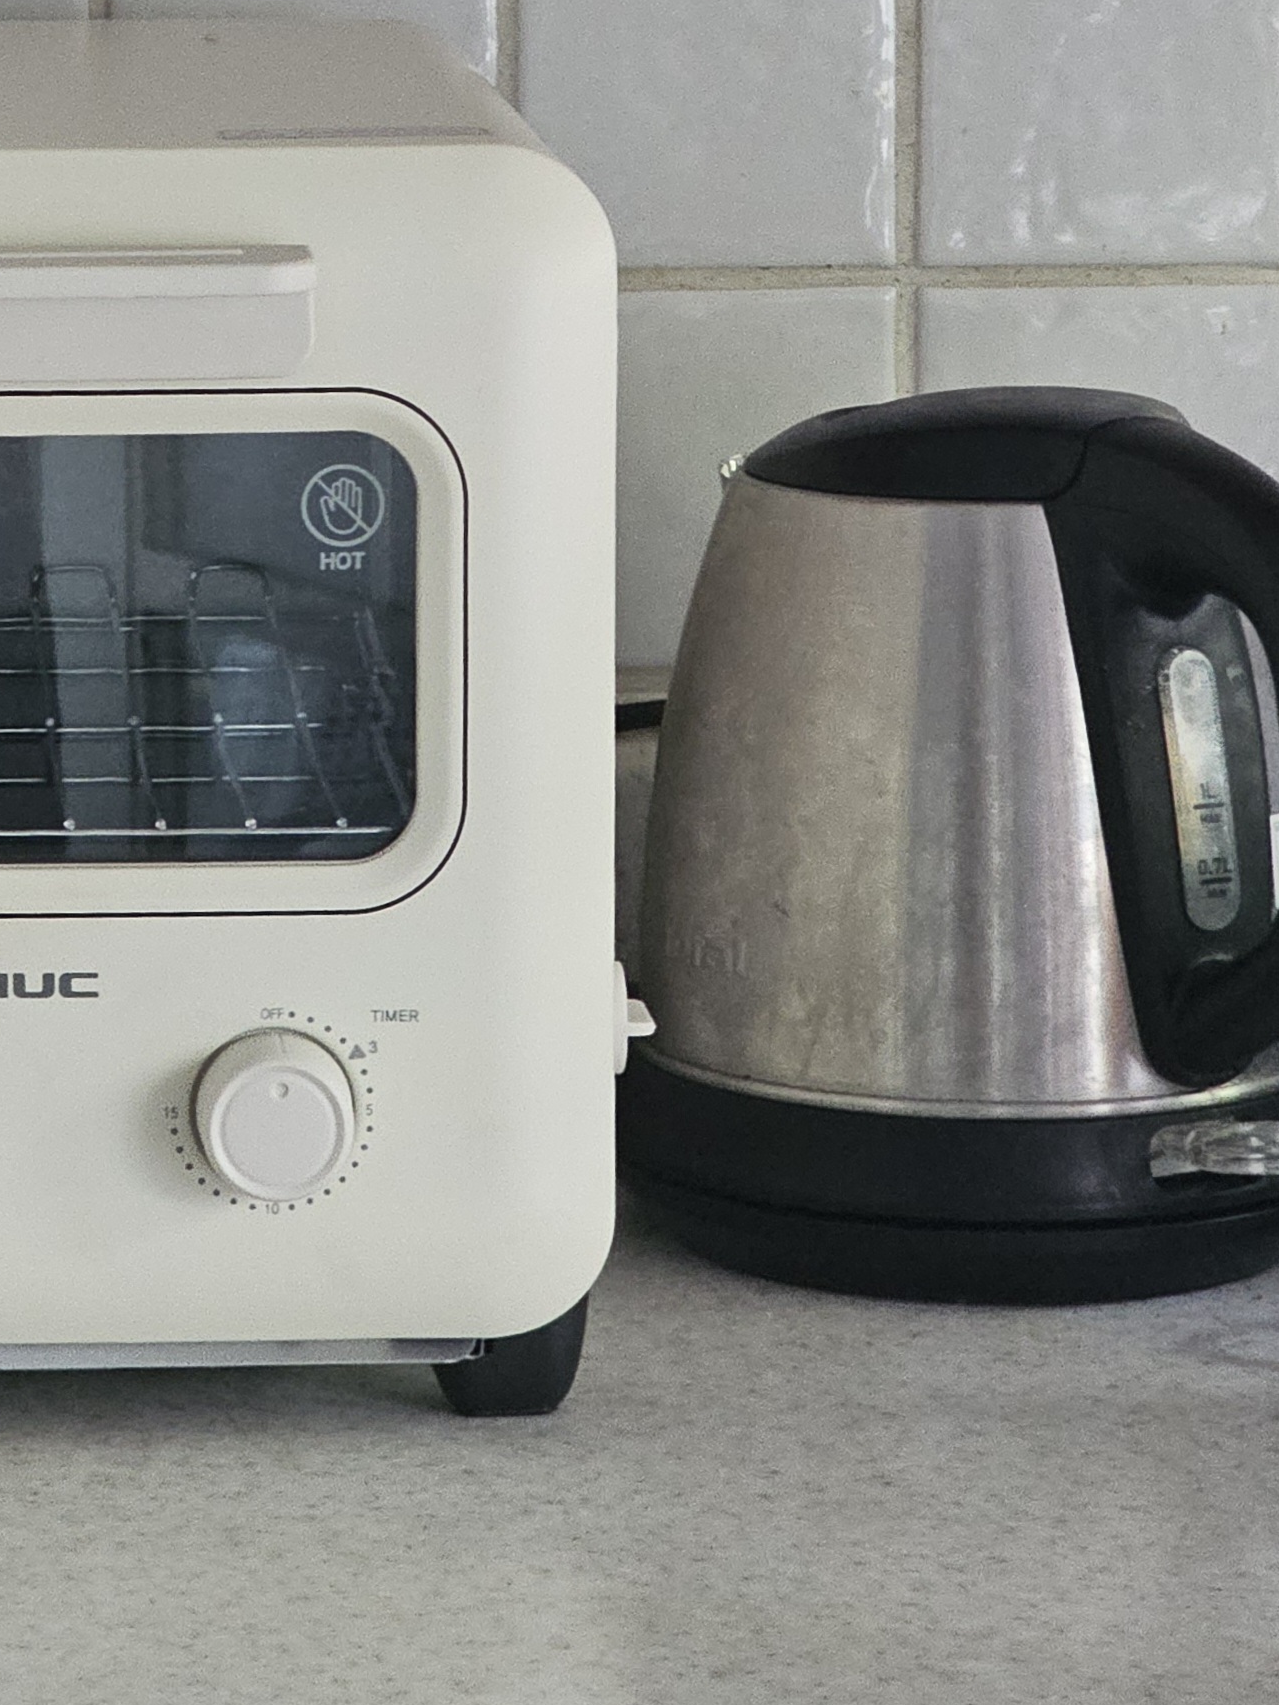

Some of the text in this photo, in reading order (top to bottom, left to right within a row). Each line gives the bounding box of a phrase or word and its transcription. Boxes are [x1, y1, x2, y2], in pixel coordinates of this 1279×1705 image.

[319, 552, 365, 570] HOT
[260, 1007, 284, 1021] OFF
[371, 1008, 420, 1023] TIMER
[369, 1041, 379, 1054] 3
[164, 1106, 179, 1119] 15
[365, 1104, 373, 1116] 5
[265, 1202, 280, 1215] 10
